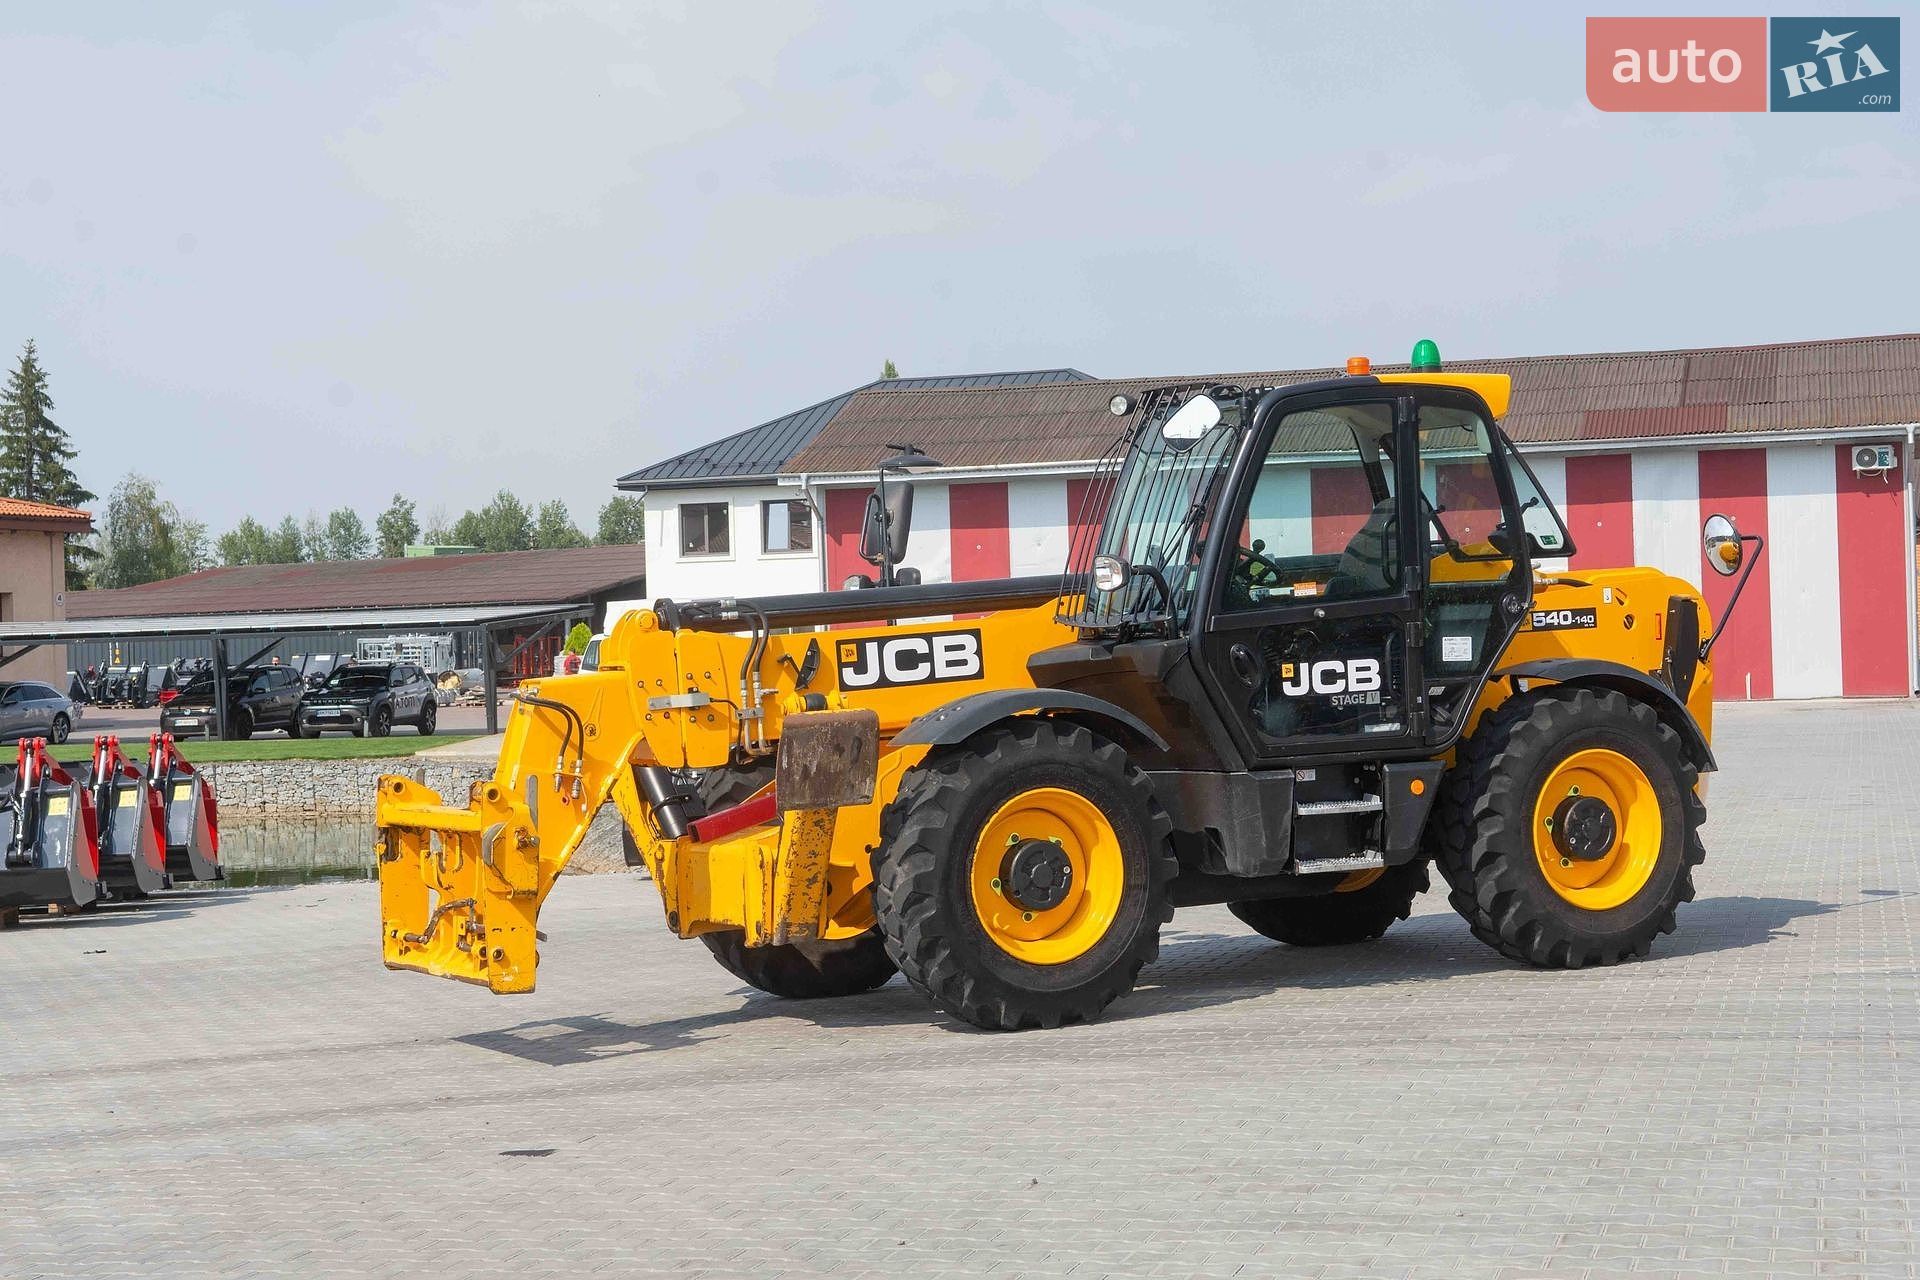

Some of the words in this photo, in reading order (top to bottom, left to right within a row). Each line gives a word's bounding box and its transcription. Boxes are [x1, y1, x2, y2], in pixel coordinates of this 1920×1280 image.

[842, 634, 980, 686] JCB
[1282, 659, 1381, 696] JCB
[1331, 693, 1365, 706] STAGE
